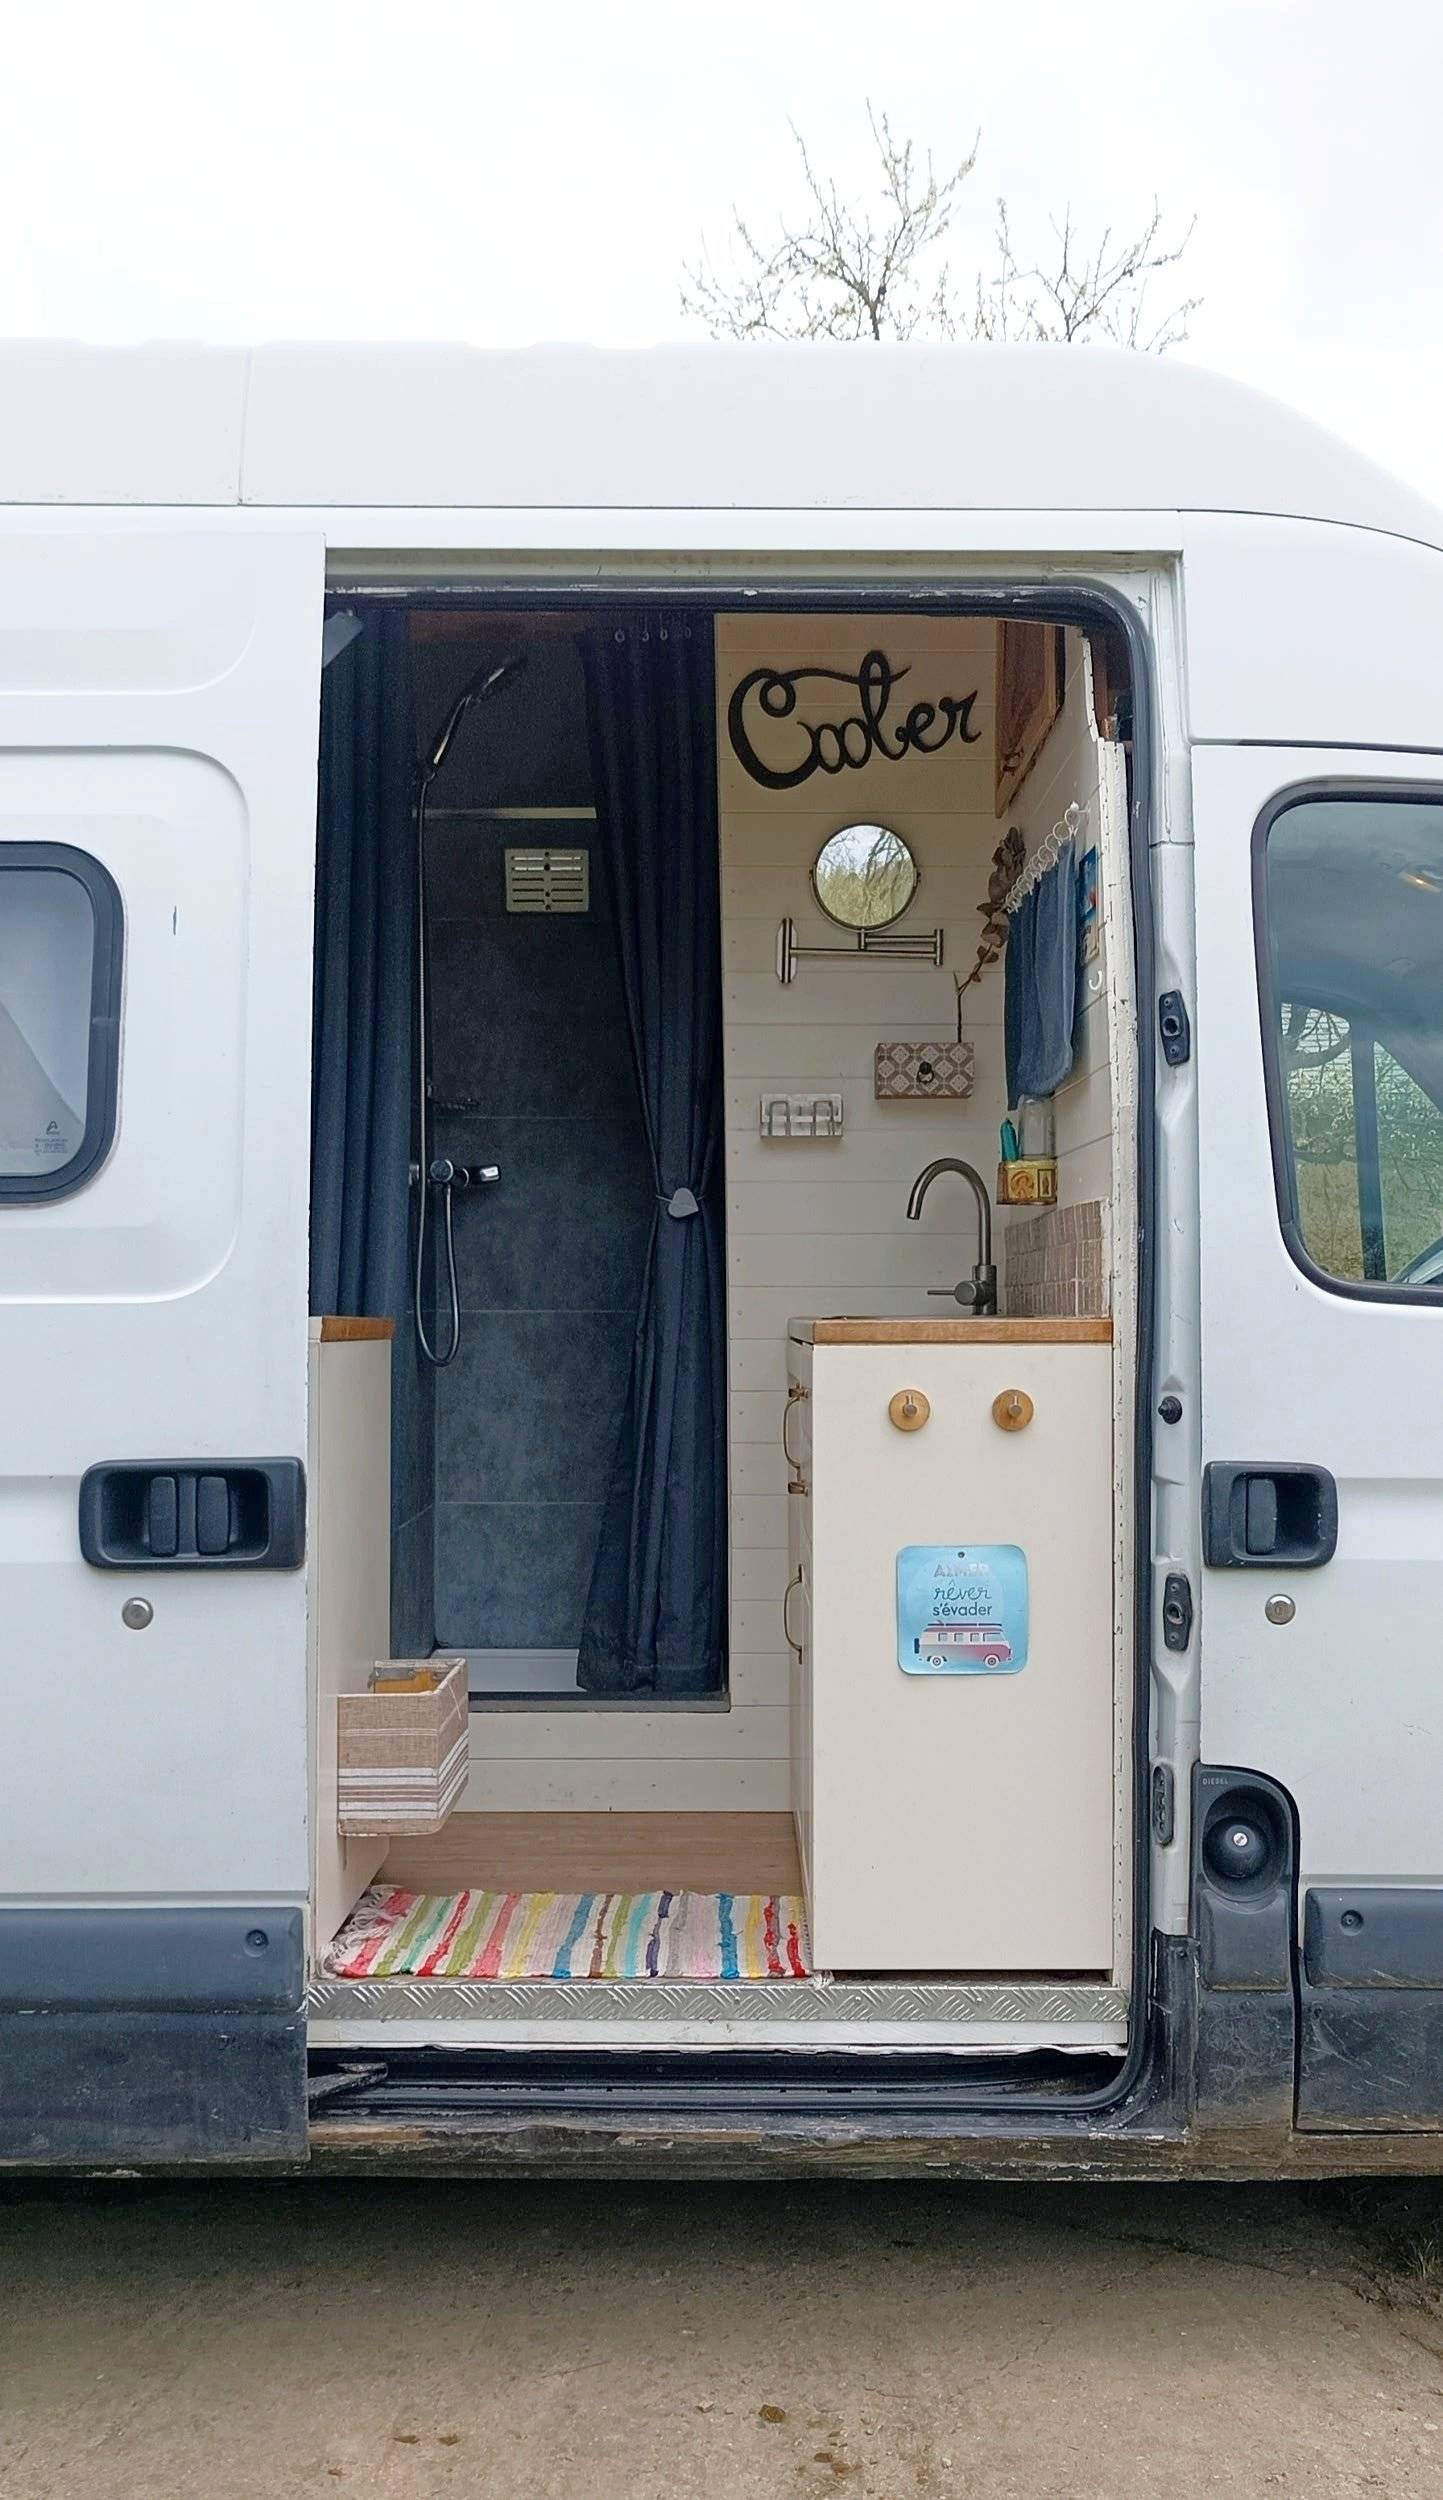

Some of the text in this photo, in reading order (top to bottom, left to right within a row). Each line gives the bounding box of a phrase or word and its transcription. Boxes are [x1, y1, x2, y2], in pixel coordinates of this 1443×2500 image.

[933, 1579, 993, 1601] rêver
[932, 1601, 993, 1617] s'évader
[1202, 1777, 1229, 1785] DIESEL
